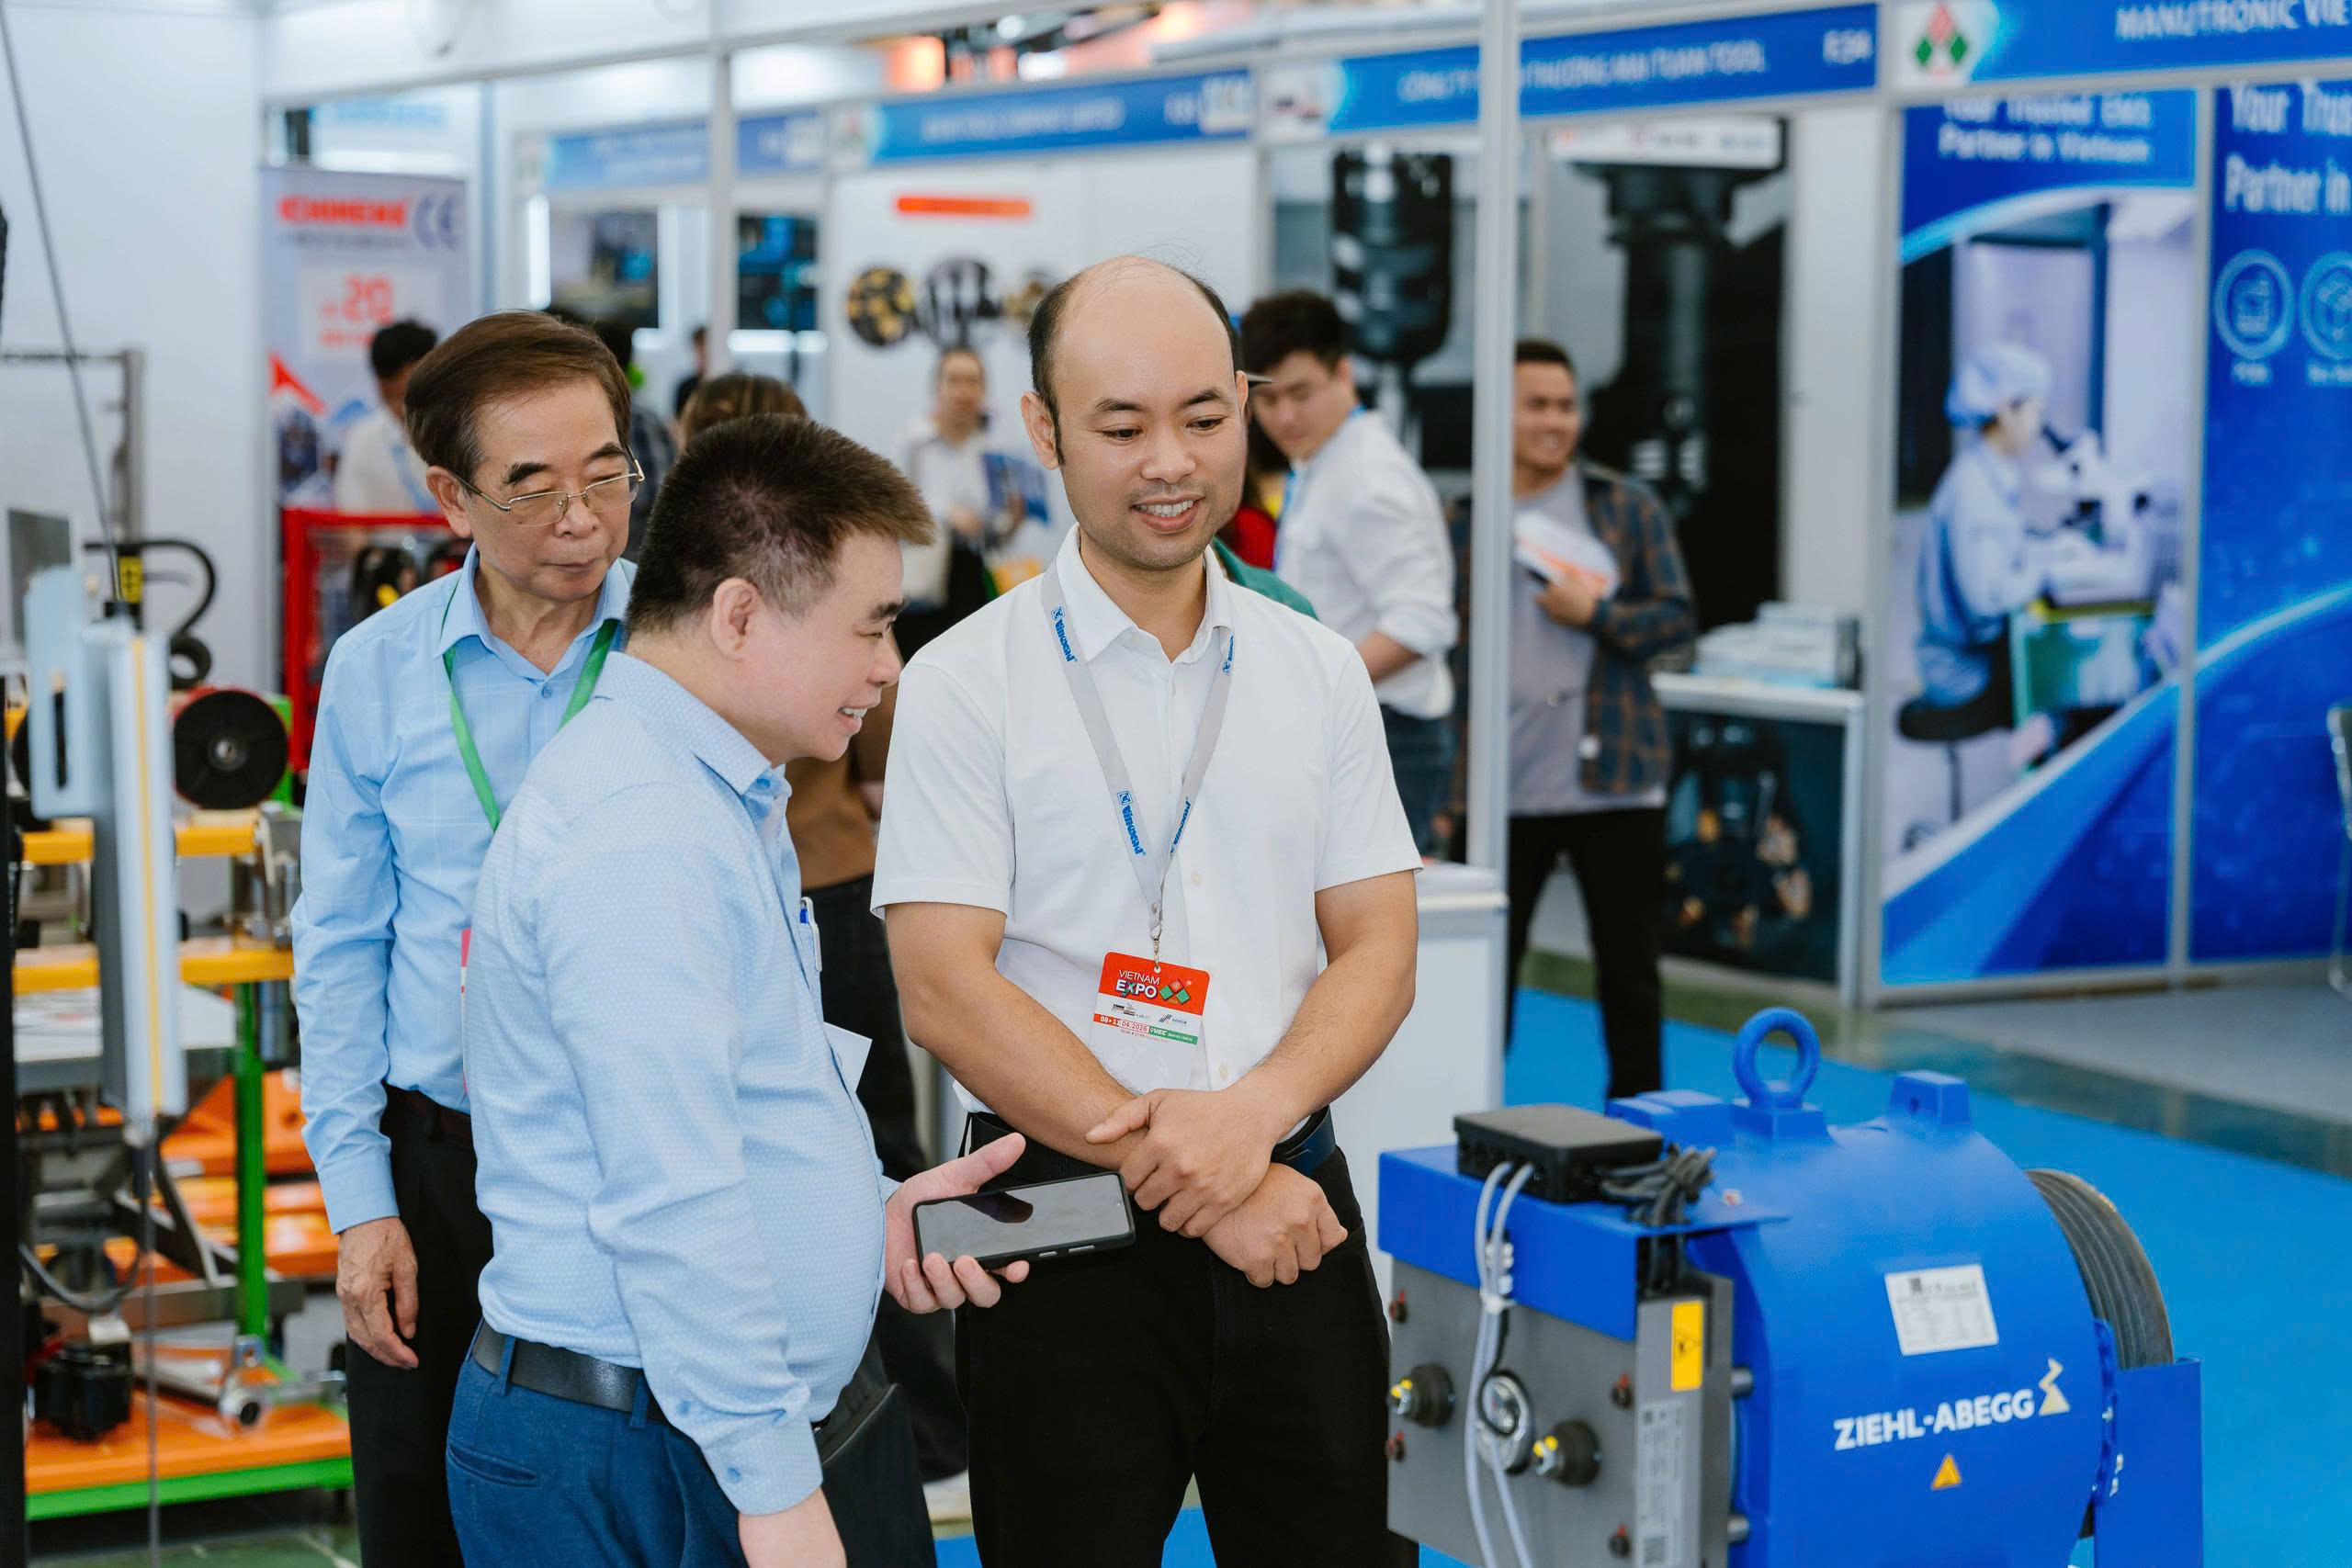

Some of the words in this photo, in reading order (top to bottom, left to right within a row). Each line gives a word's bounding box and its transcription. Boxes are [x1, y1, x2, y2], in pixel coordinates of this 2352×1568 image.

[1938, 122, 2027, 160] Partner
[2225, 153, 2321, 213] Partner
[1115, 978, 1158, 999] EXPO
[1118, 969, 1160, 986] VIETNAM
[1834, 1389, 2035, 1452] ZIEHL-ABEGG
